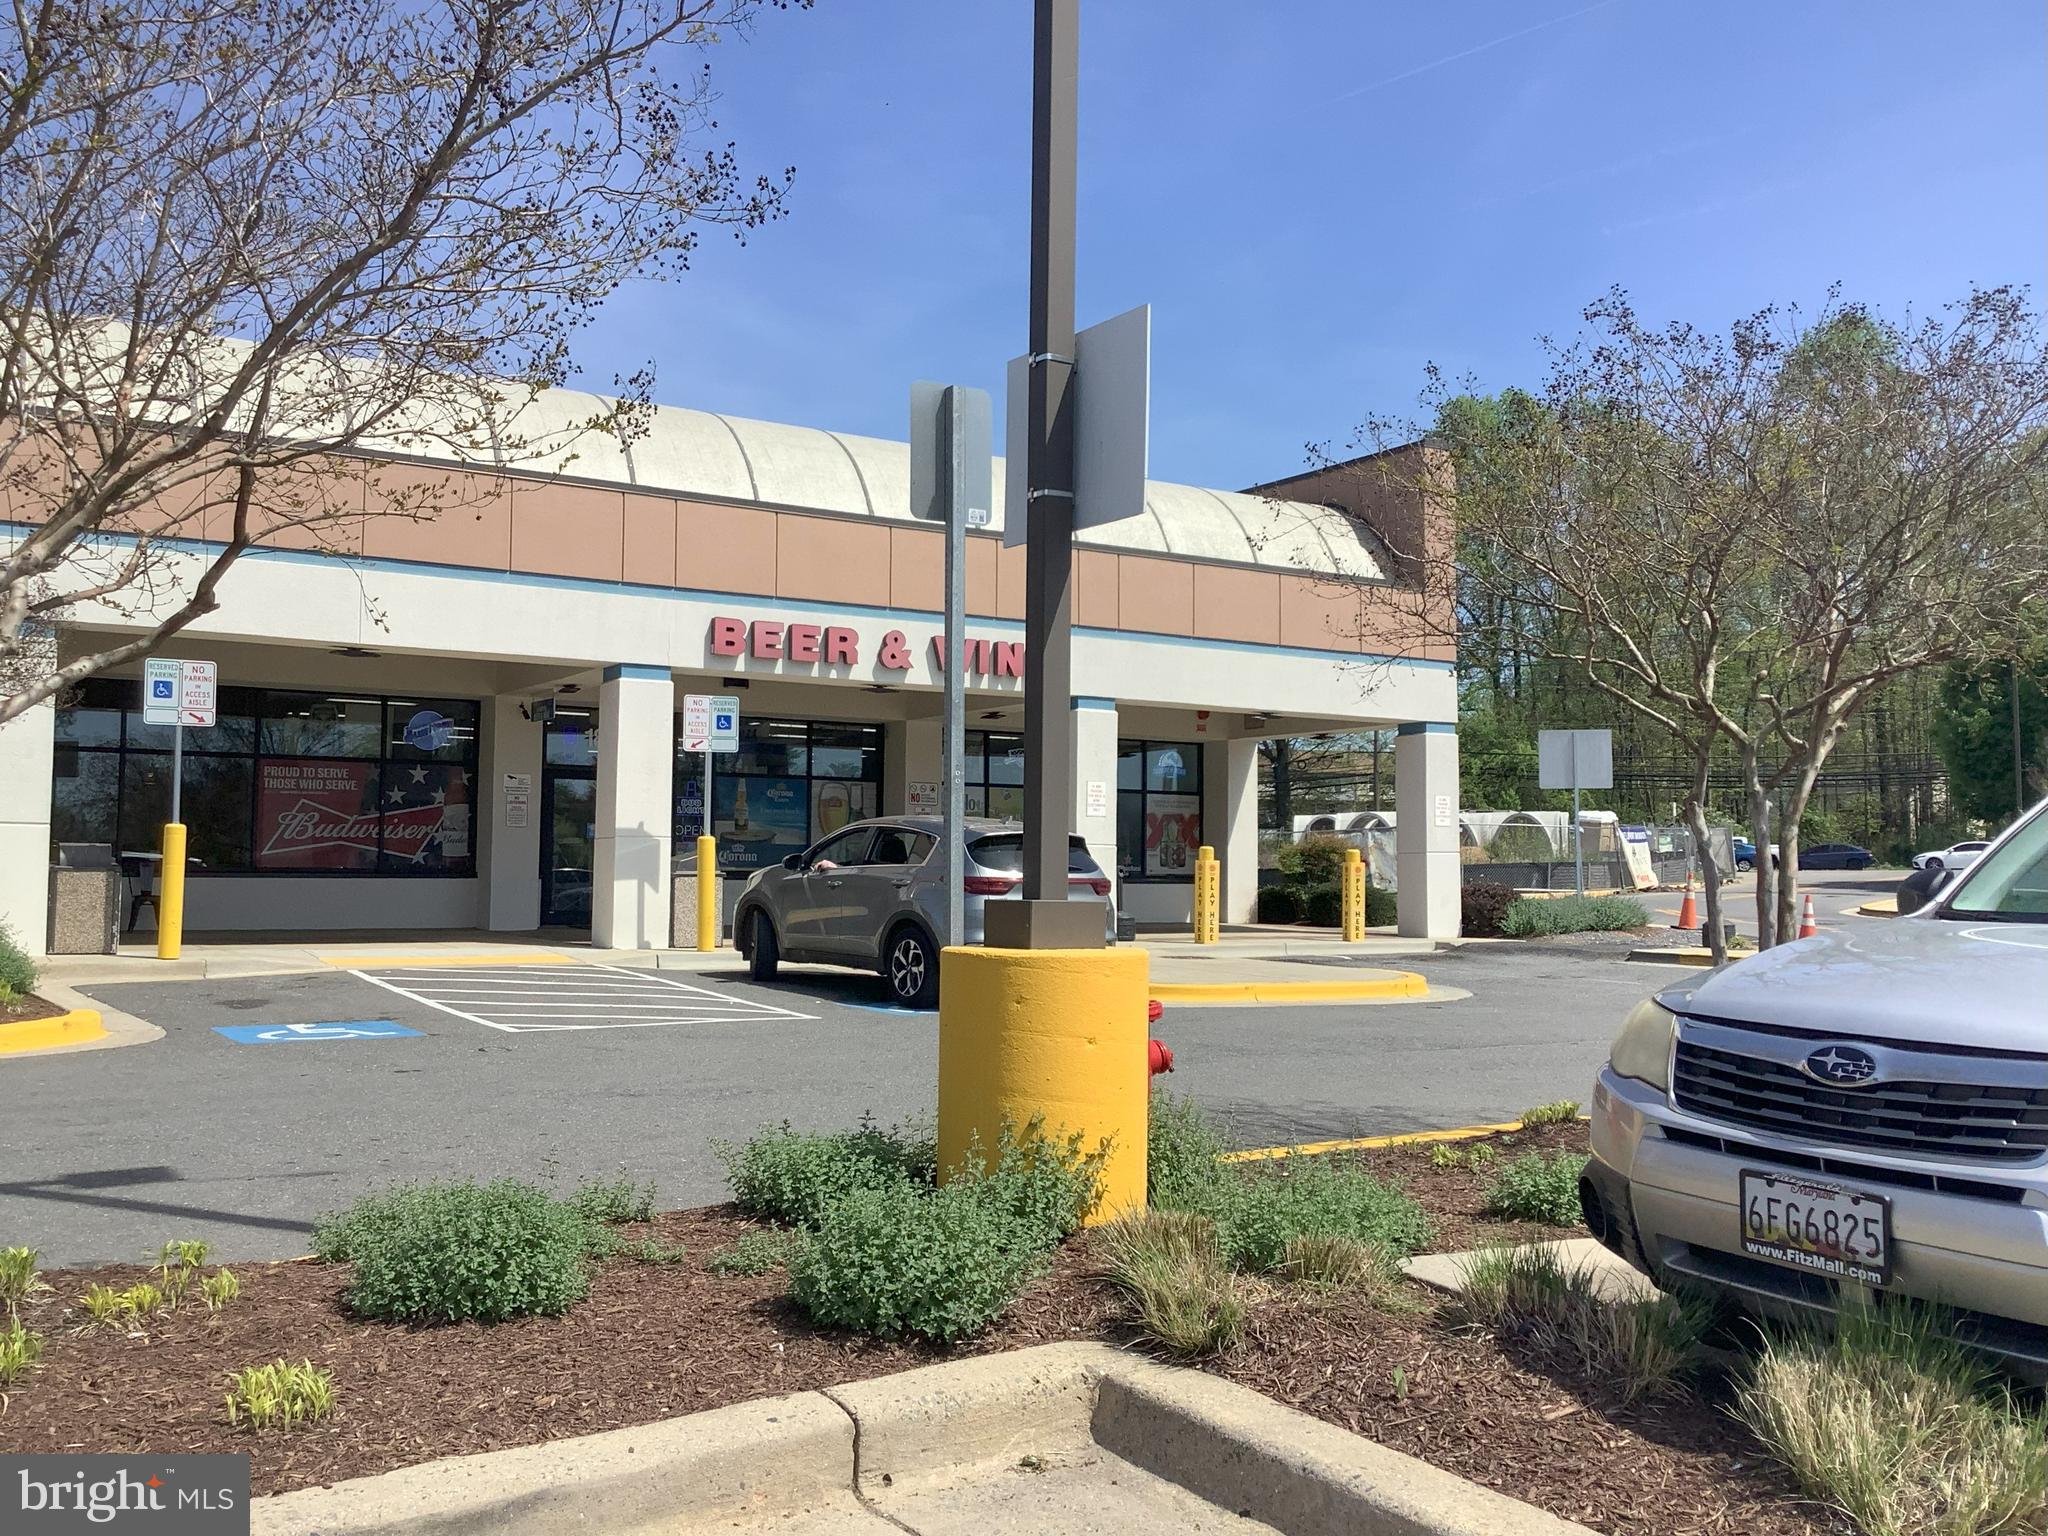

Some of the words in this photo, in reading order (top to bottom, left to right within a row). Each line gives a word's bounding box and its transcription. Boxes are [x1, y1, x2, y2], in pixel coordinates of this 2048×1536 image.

[711, 616, 859, 666] BEER
[878, 629, 914, 670] &
[931, 635, 1025, 677] WIN
[148, 662, 179, 671] RESERVED
[191, 665, 205, 674] NO
[149, 671, 178, 679] PARKING
[184, 674, 213, 682] PARKING
[185, 690, 211, 698] ACCESS
[263, 766, 300, 777] PROUD
[302, 767, 315, 778] TO
[317, 767, 350, 779] SERVE
[263, 777, 297, 789] THOSE
[299, 778, 324, 790] WHO
[325, 780, 359, 791] SERVE
[911, 792, 921, 803] NO
[278, 811, 438, 840] Budweiser
[675, 824, 705, 836] OPEN
[718, 849, 758, 863] Corona
[1750, 1195, 1881, 1259] 6FG6825
[1745, 1242, 1882, 1284] www.FitzMall.com
